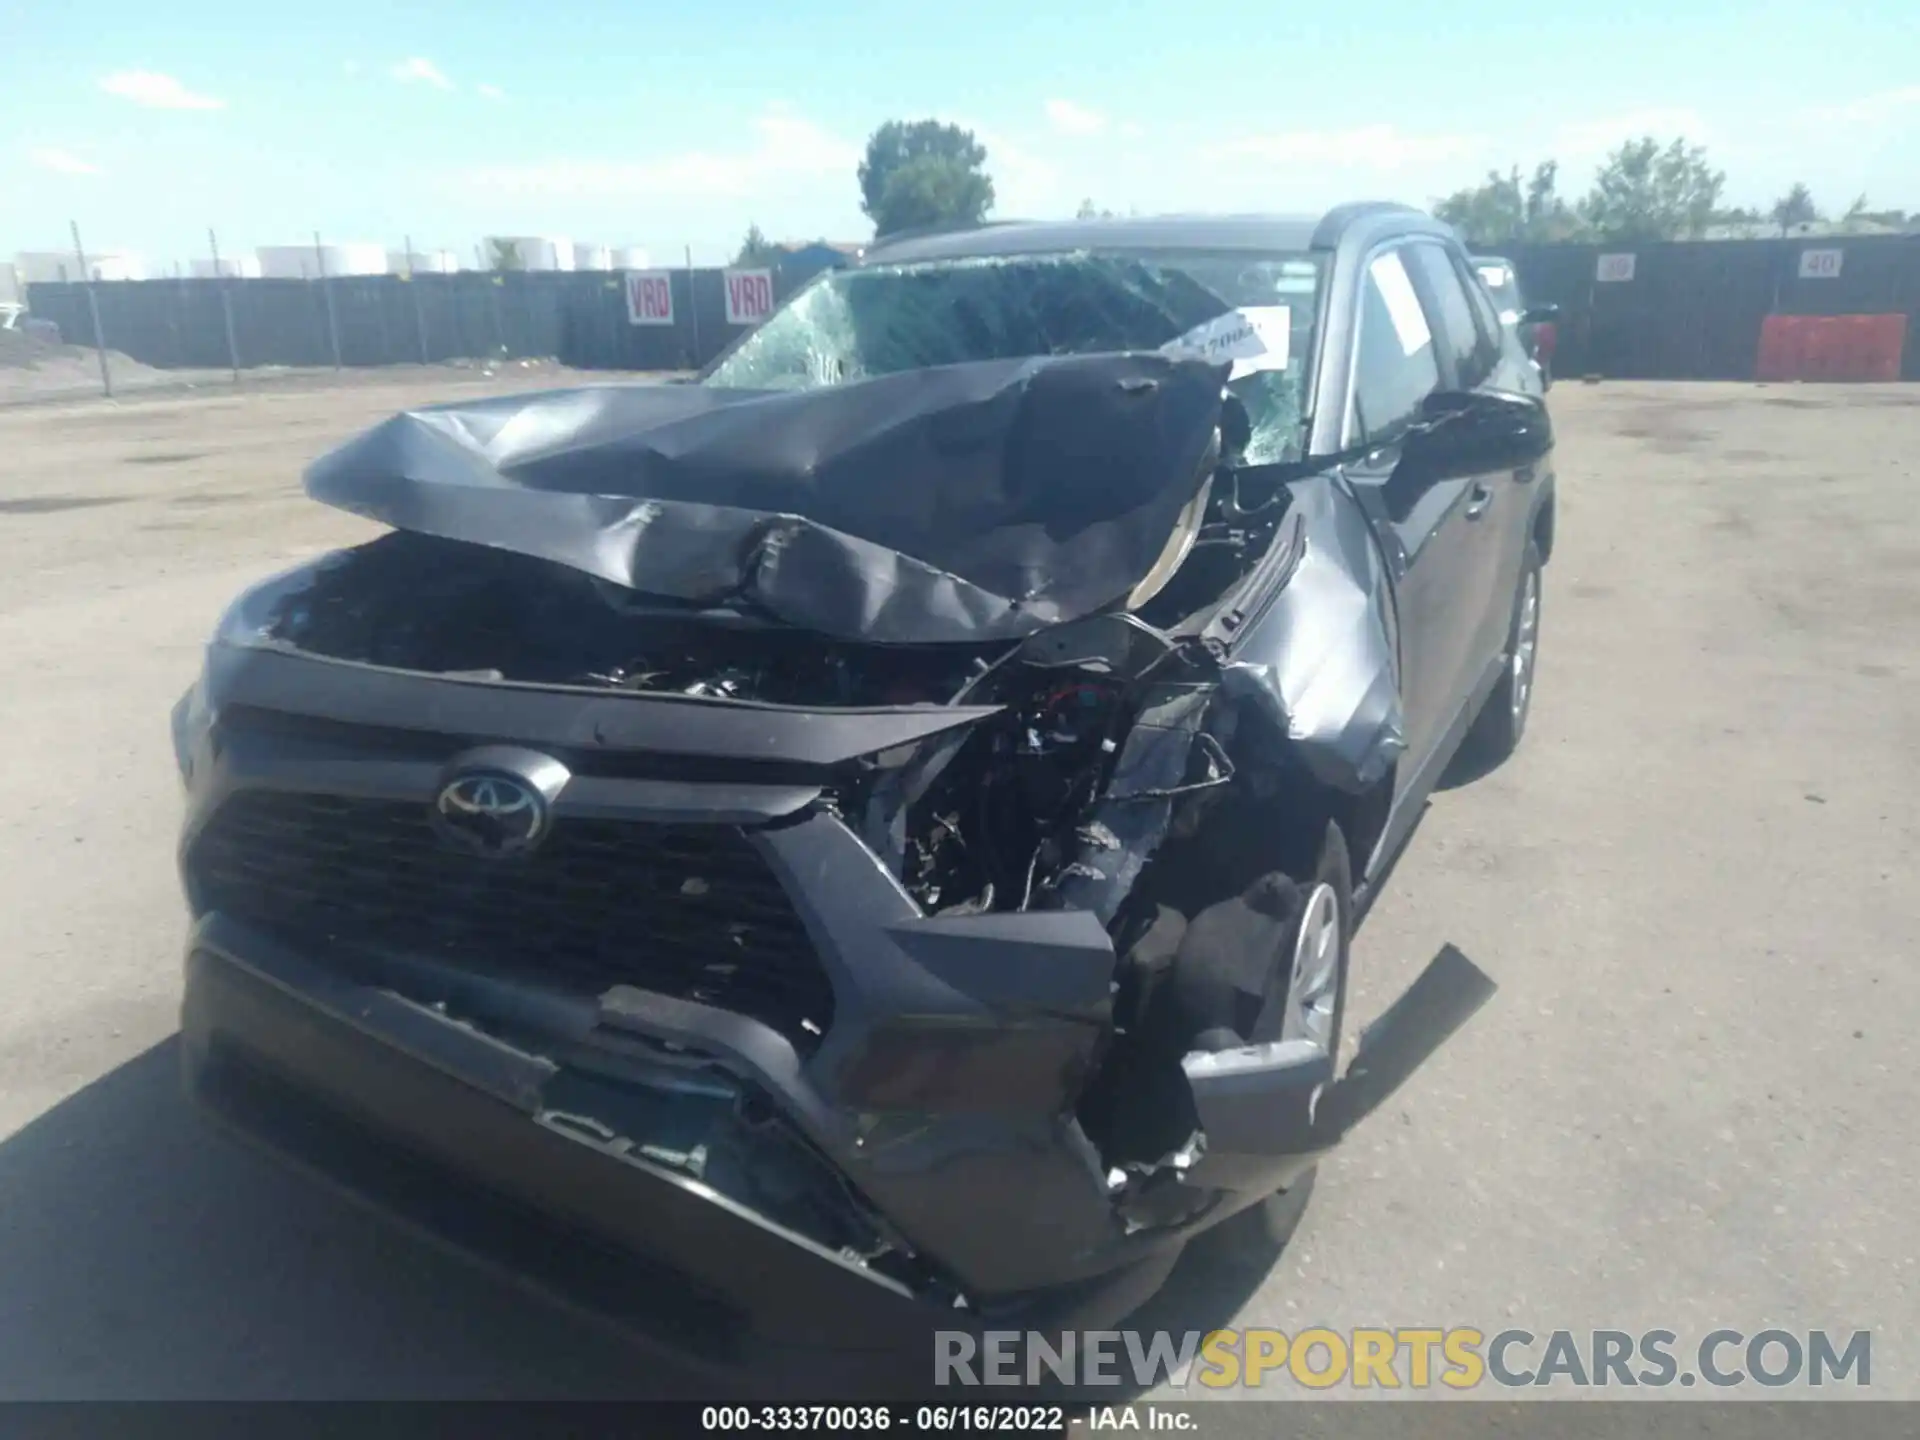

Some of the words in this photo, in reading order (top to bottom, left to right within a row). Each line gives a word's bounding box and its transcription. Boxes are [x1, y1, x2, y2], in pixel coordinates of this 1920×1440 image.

[1808, 253, 1835, 274] 40
[629, 278, 669, 318] VRD
[728, 275, 770, 317] VRD
